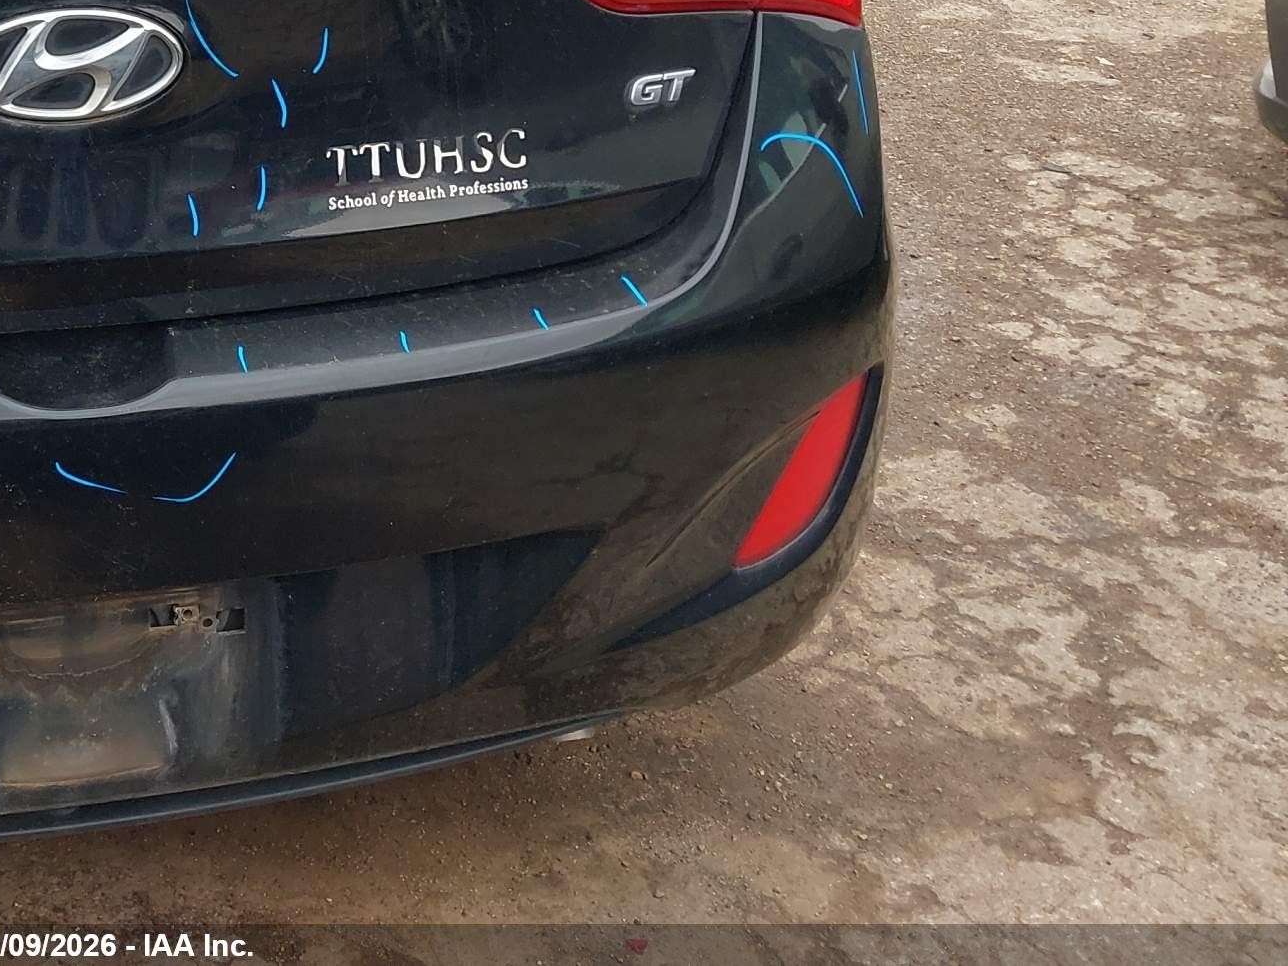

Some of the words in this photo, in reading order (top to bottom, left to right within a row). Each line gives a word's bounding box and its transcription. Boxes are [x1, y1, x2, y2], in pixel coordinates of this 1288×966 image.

[631, 68, 697, 106] GT
[326, 128, 527, 187] TTUHSC
[328, 192, 378, 211] School
[380, 190, 397, 208] of
[397, 186, 447, 203] Health
[450, 177, 529, 197] Professions
